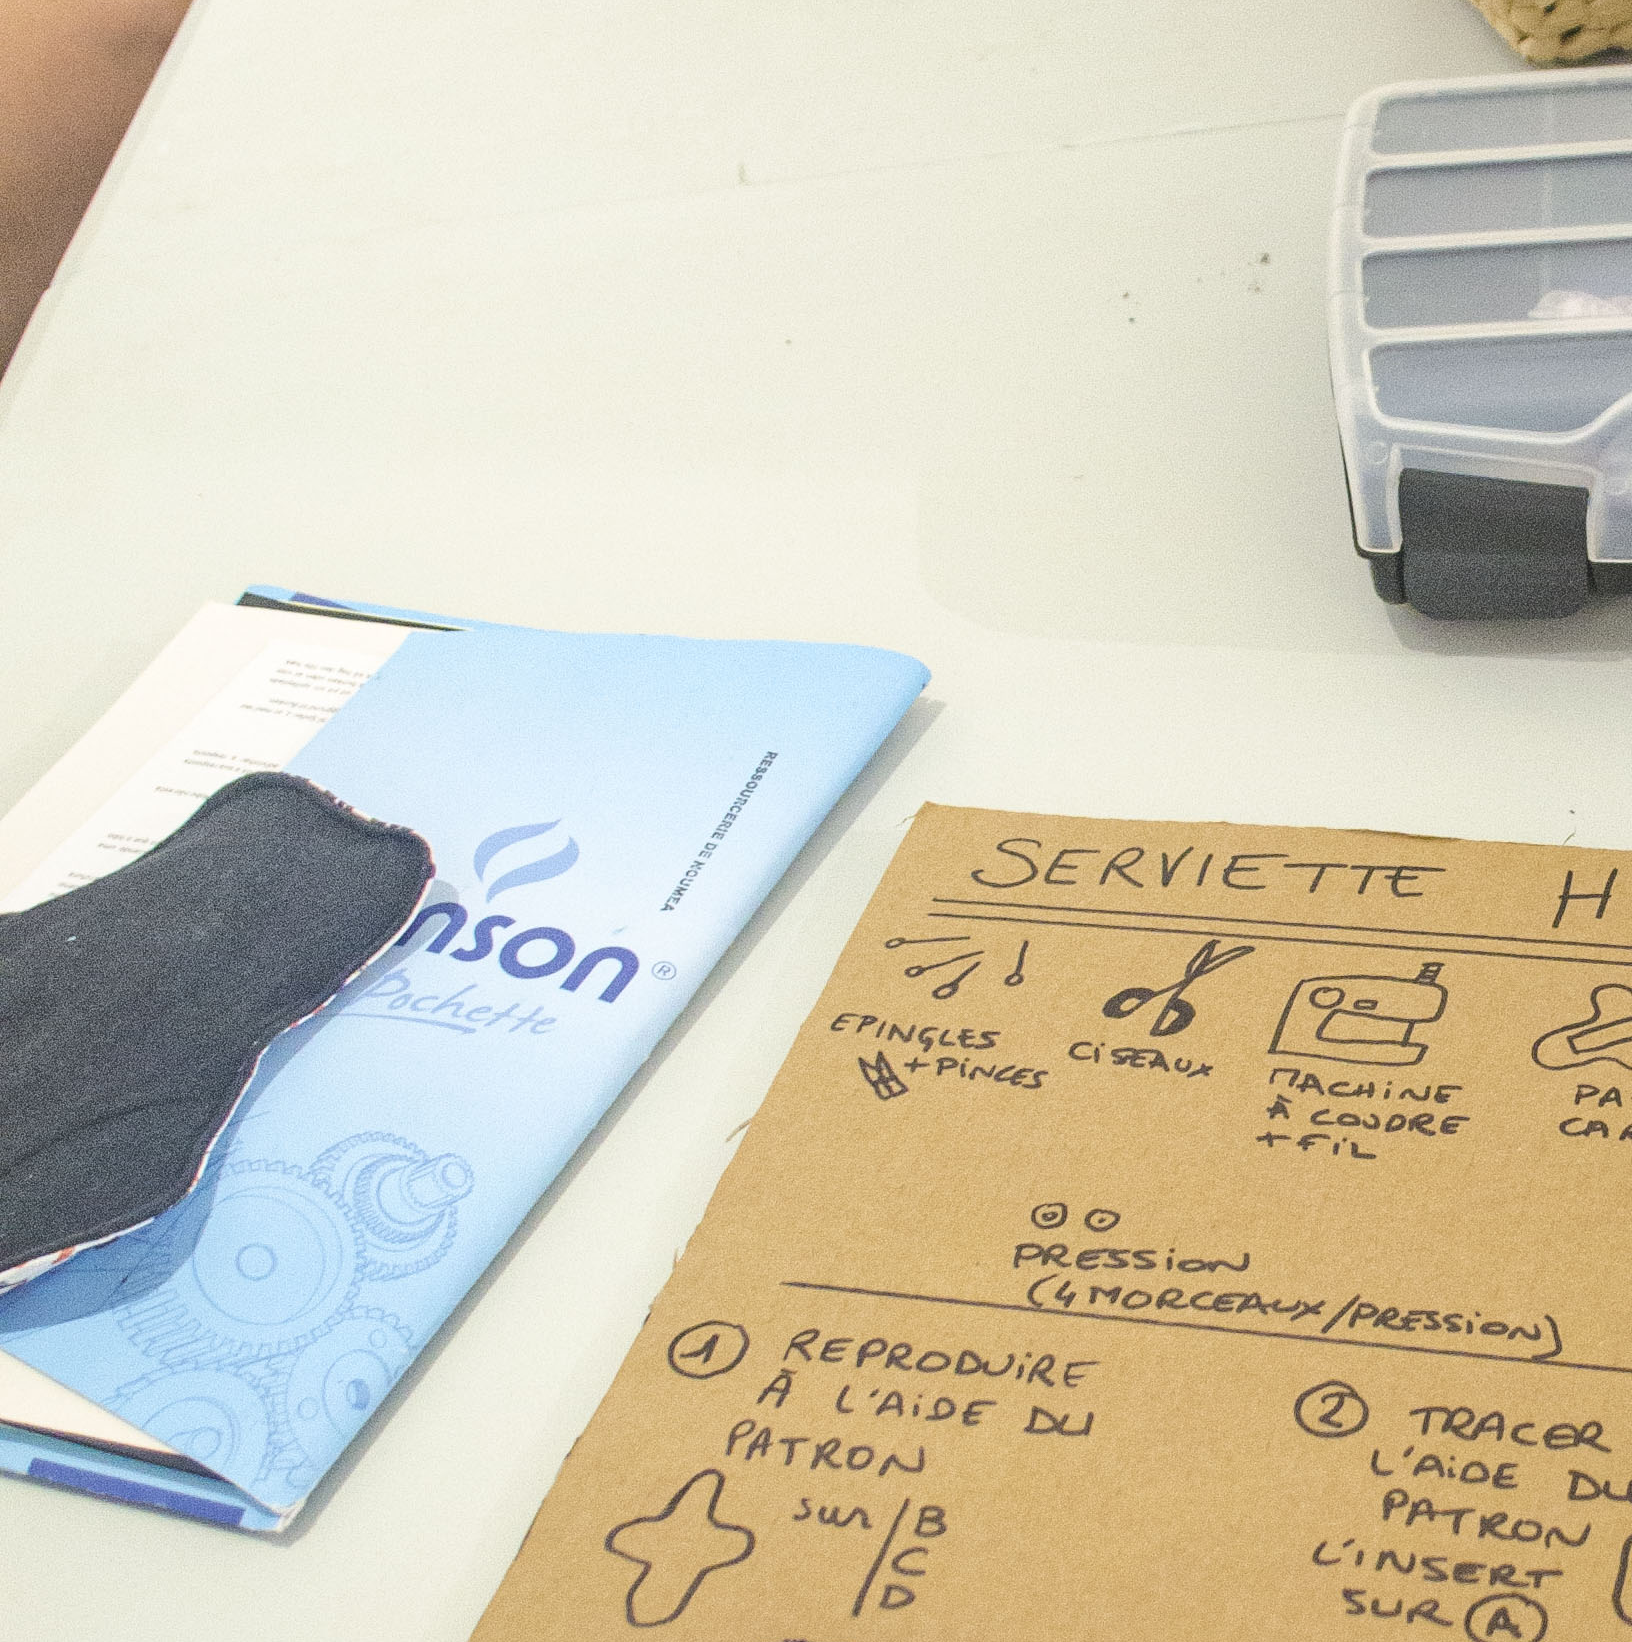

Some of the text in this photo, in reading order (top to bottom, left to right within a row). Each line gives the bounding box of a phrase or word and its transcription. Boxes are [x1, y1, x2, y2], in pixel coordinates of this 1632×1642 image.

[660, 750, 779, 912] RESSOURCERIE DE NOUMEA
[971, 838, 1446, 898] SERVIETTE
[393, 901, 640, 1004] nson
[361, 968, 558, 1035] Pochette
[830, 1013, 1000, 1053] EPINGLES
[1267, 1094, 1470, 1136] À COUDRE
[1024, 1406, 1094, 1436] DU
[1410, 1406, 1611, 1453] TRACER
[726, 1419, 925, 1477] PATRON
[1383, 1488, 1591, 1548] PATRON
[891, 1547, 928, 1576] C
[879, 1584, 916, 1610] D
[1342, 1588, 1453, 1627] SUR
